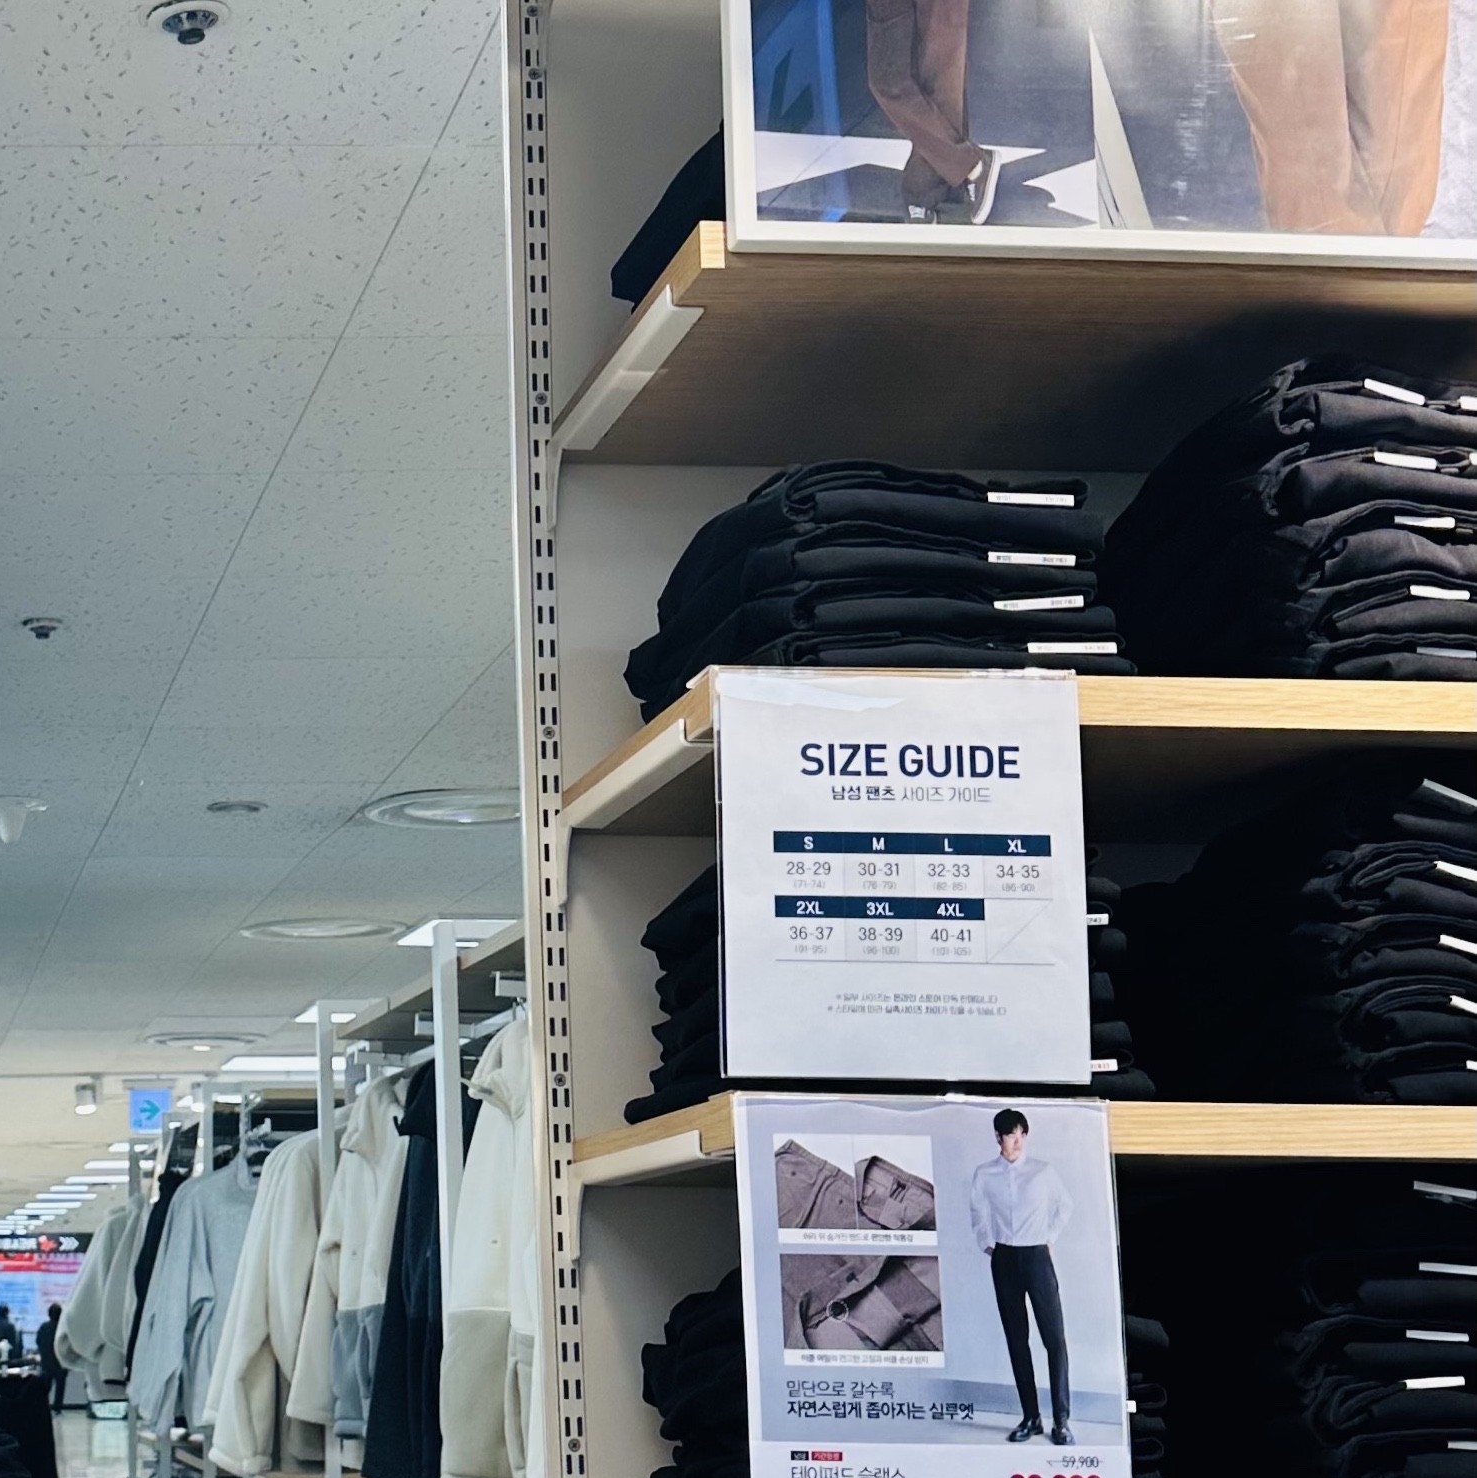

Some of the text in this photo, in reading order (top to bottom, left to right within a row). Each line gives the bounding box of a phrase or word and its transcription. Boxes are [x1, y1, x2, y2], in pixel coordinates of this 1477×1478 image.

[800, 743, 1021, 779] SIZE GUIDE
[831, 786, 992, 803] 남성 팬츠 사이즈 가이드
[804, 837, 1027, 853] S M L XL
[786, 862, 1040, 879] 28-29 30-31 32-33 34-35
[796, 901, 964, 917] 2XL 3XL 4XL
[789, 927, 972, 943] 36-37 38-39 40-41
[787, 1380, 895, 1399] 밑단으로 갈수록
[787, 1401, 974, 1420] 자연스럽게 좁아지는 실루엣
[1062, 1456, 1099, 1469] 59,900
